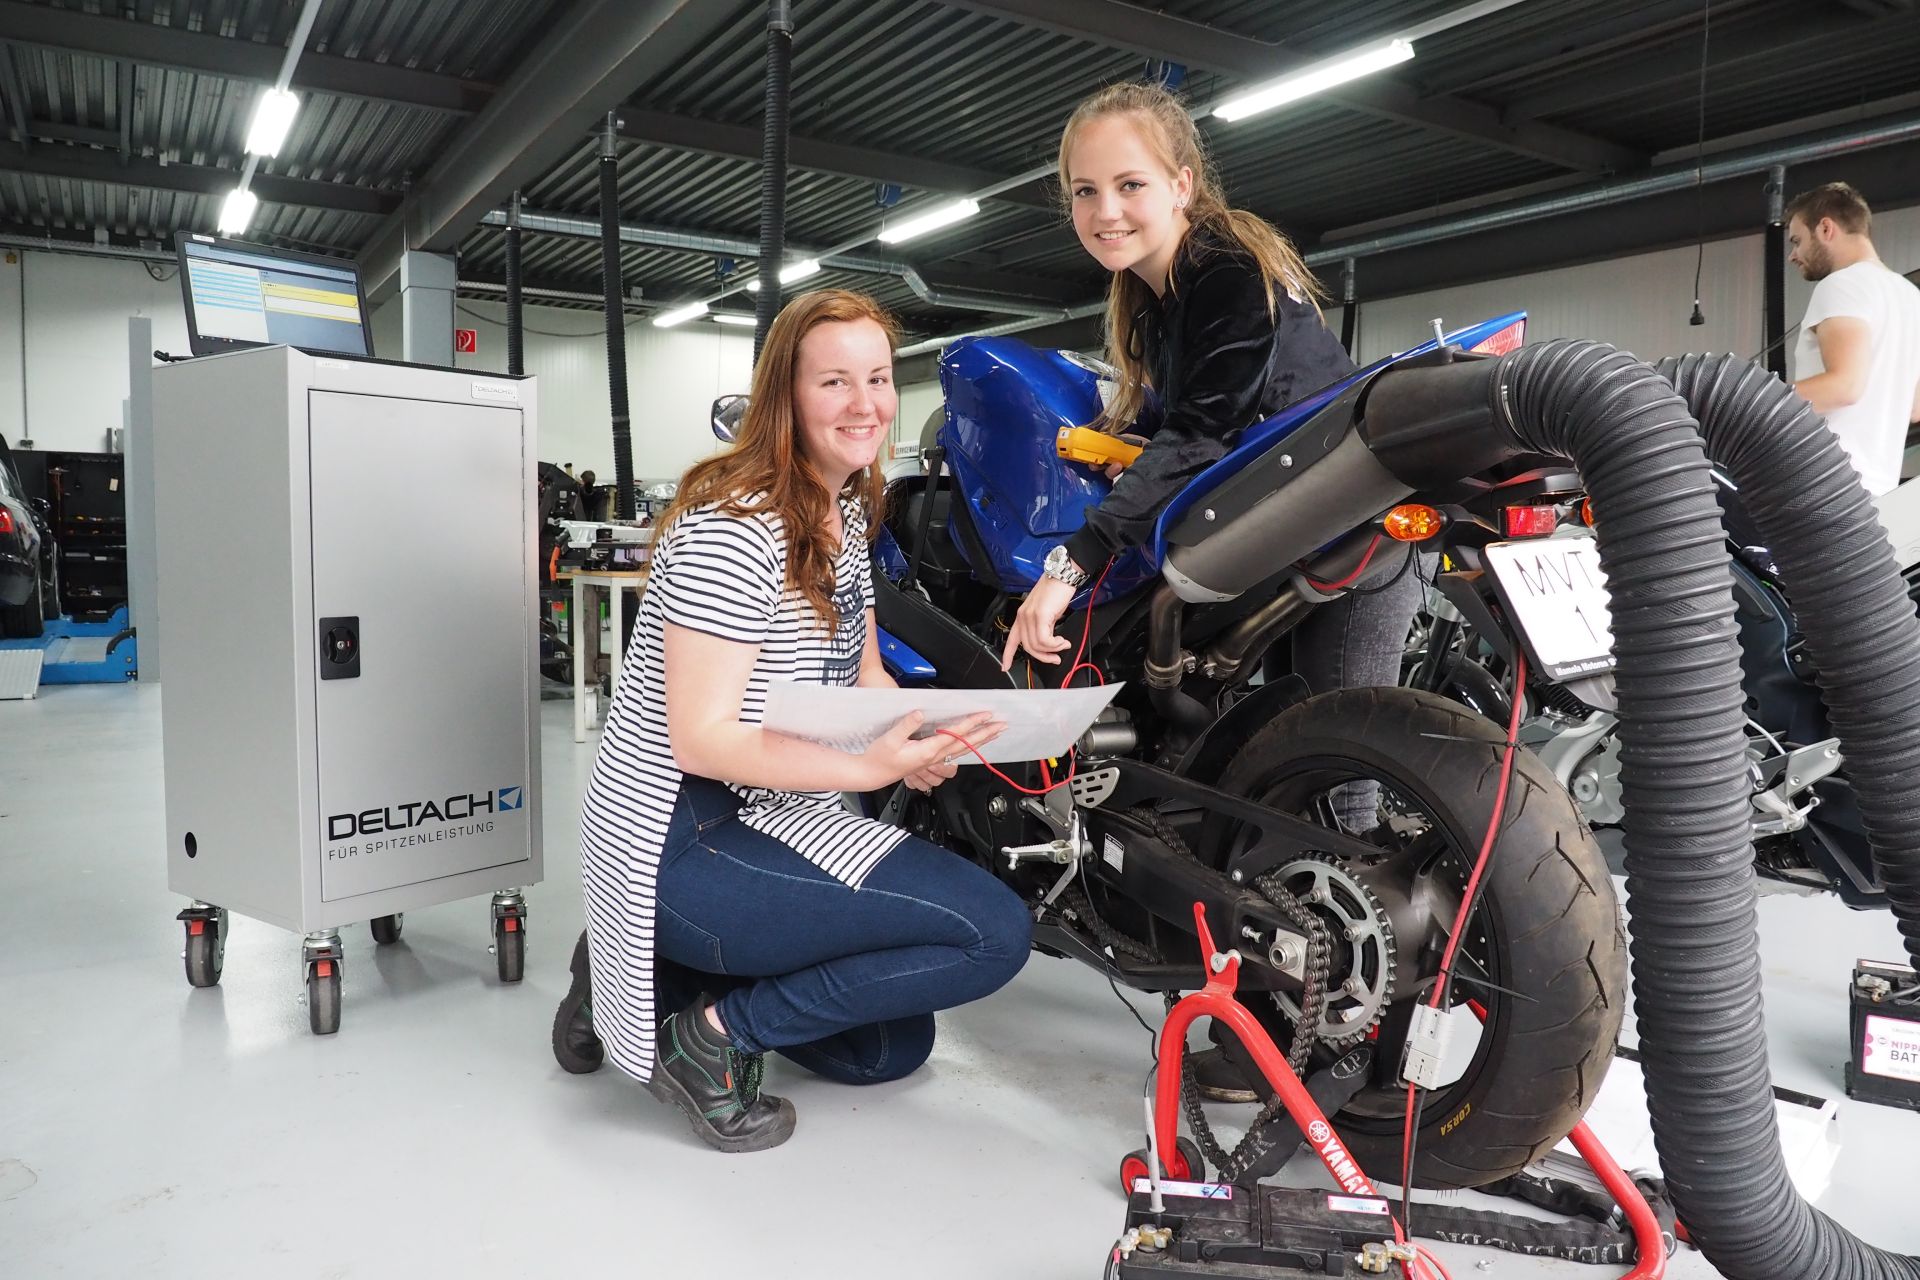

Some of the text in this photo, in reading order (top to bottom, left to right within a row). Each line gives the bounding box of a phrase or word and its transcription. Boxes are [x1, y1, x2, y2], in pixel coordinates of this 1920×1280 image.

[1513, 551, 1594, 596] MVT
[328, 790, 493, 841] DELTACH
[329, 821, 494, 860] FÜR SPITZENLEISTUNG
[1440, 1103, 1471, 1136] CORSA
